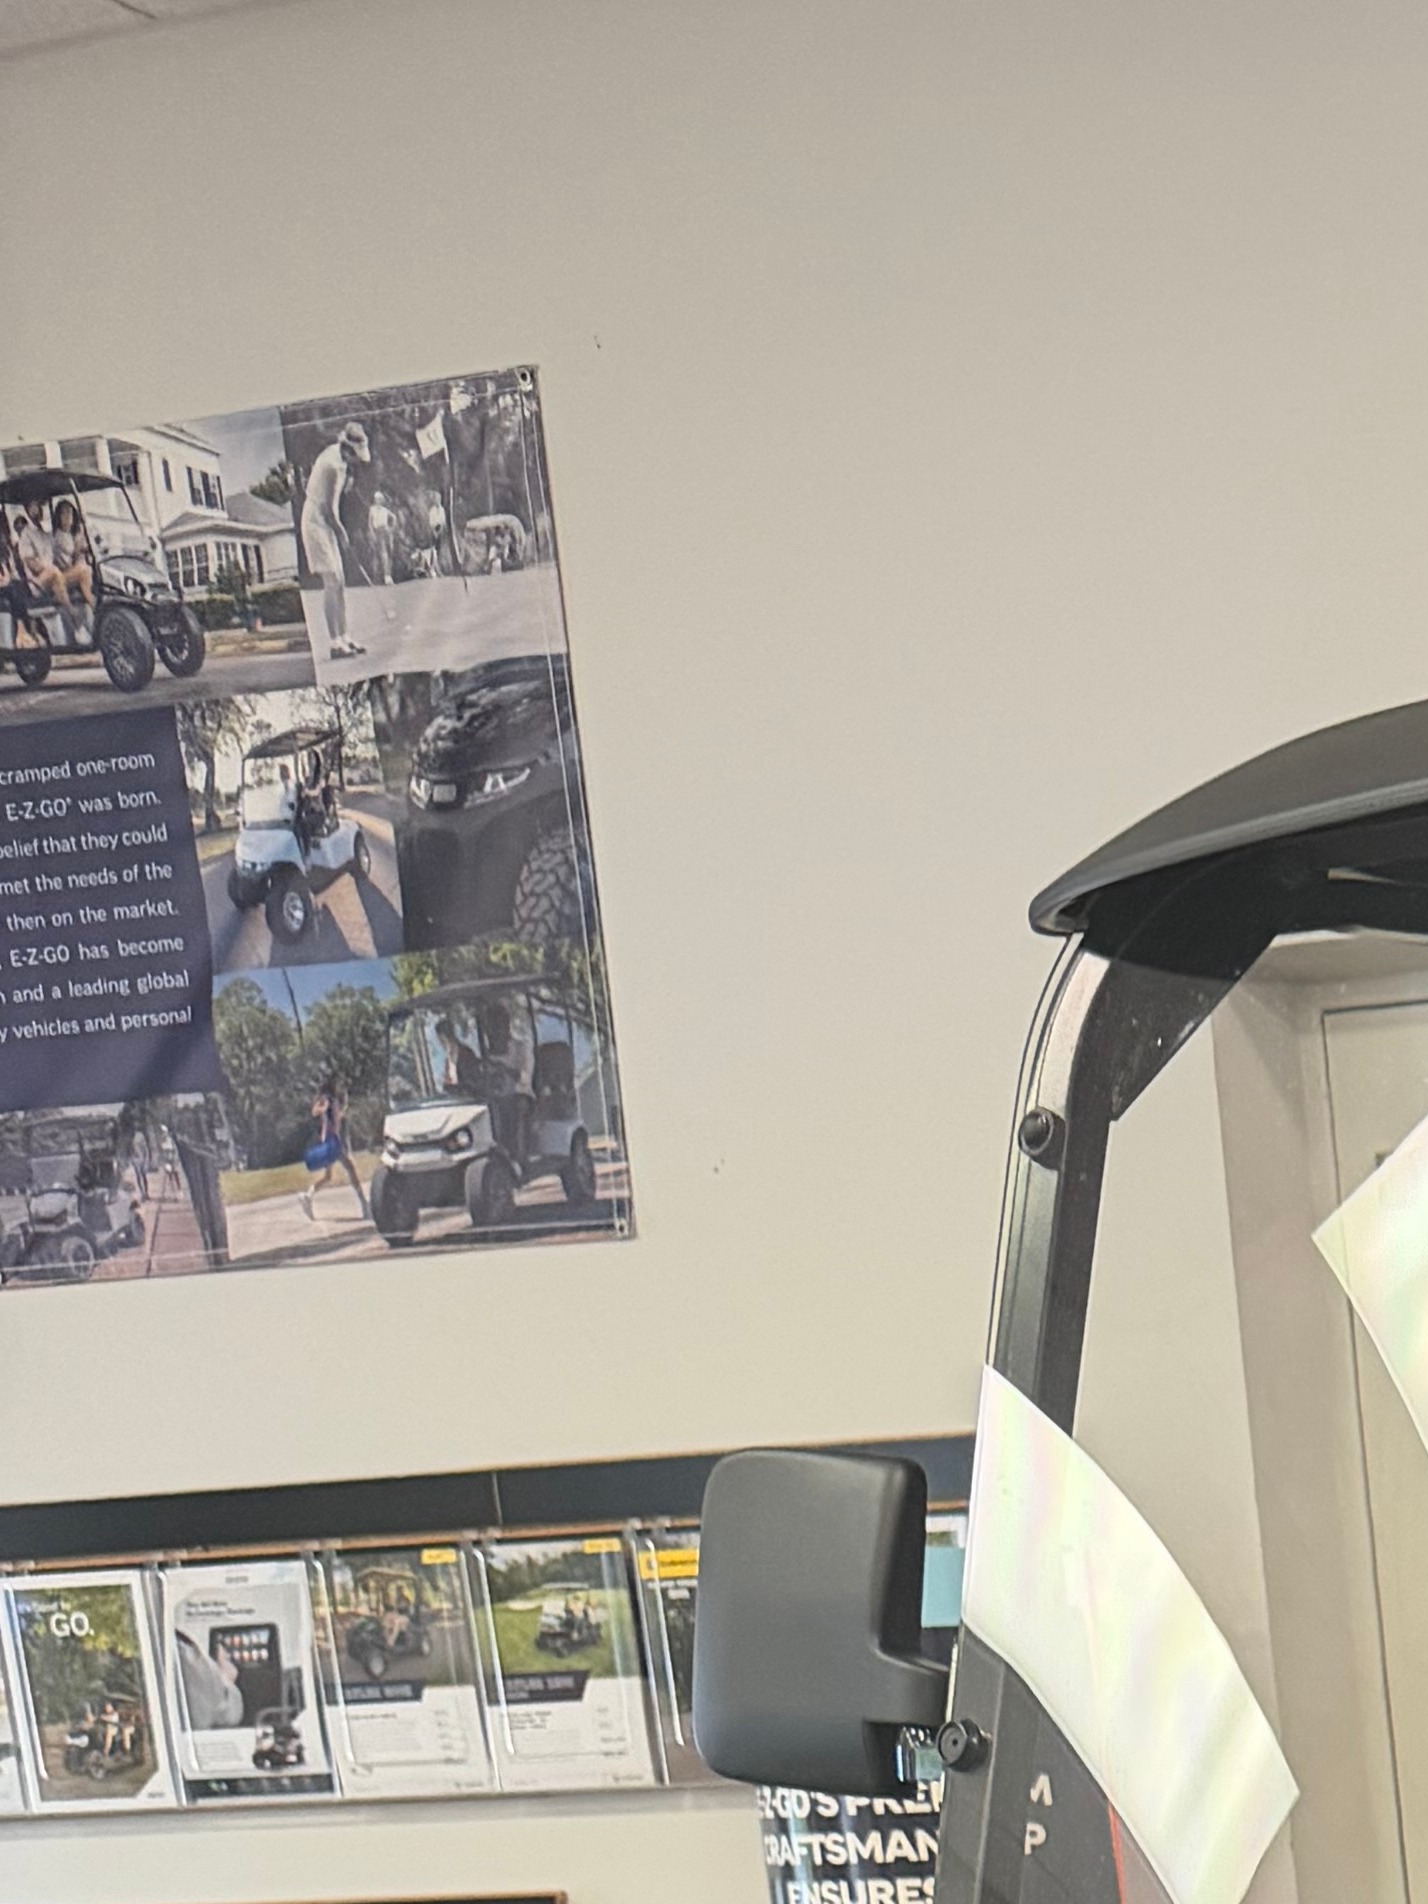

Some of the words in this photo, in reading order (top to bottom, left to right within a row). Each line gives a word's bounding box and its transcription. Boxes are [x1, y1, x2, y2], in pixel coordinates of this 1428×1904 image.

[76, 753, 155, 776] one-room
[78, 797, 112, 813] was
[118, 790, 161, 809] born.
[42, 835, 77, 854] that
[81, 832, 118, 851] they
[122, 822, 168, 846] could
[35, 873, 62, 892] the
[68, 867, 118, 889] needs
[123, 863, 139, 882] of
[144, 861, 172, 880] the
[6, 913, 46, 932] then
[51, 911, 73, 927] on
[79, 905, 107, 924] the
[113, 898, 179, 921] market.
[9, 944, 70, 968] E-Z-GO
[78, 941, 109, 960] has
[117, 936, 184, 957] become
[12, 983, 44, 1004] and
[51, 985, 62, 999] a
[68, 978, 130, 997] leading
[137, 969, 190, 995] global
[13, 1016, 80, 1039] vehicles
[84, 1012, 116, 1033] and
[120, 1005, 192, 1032] personal
